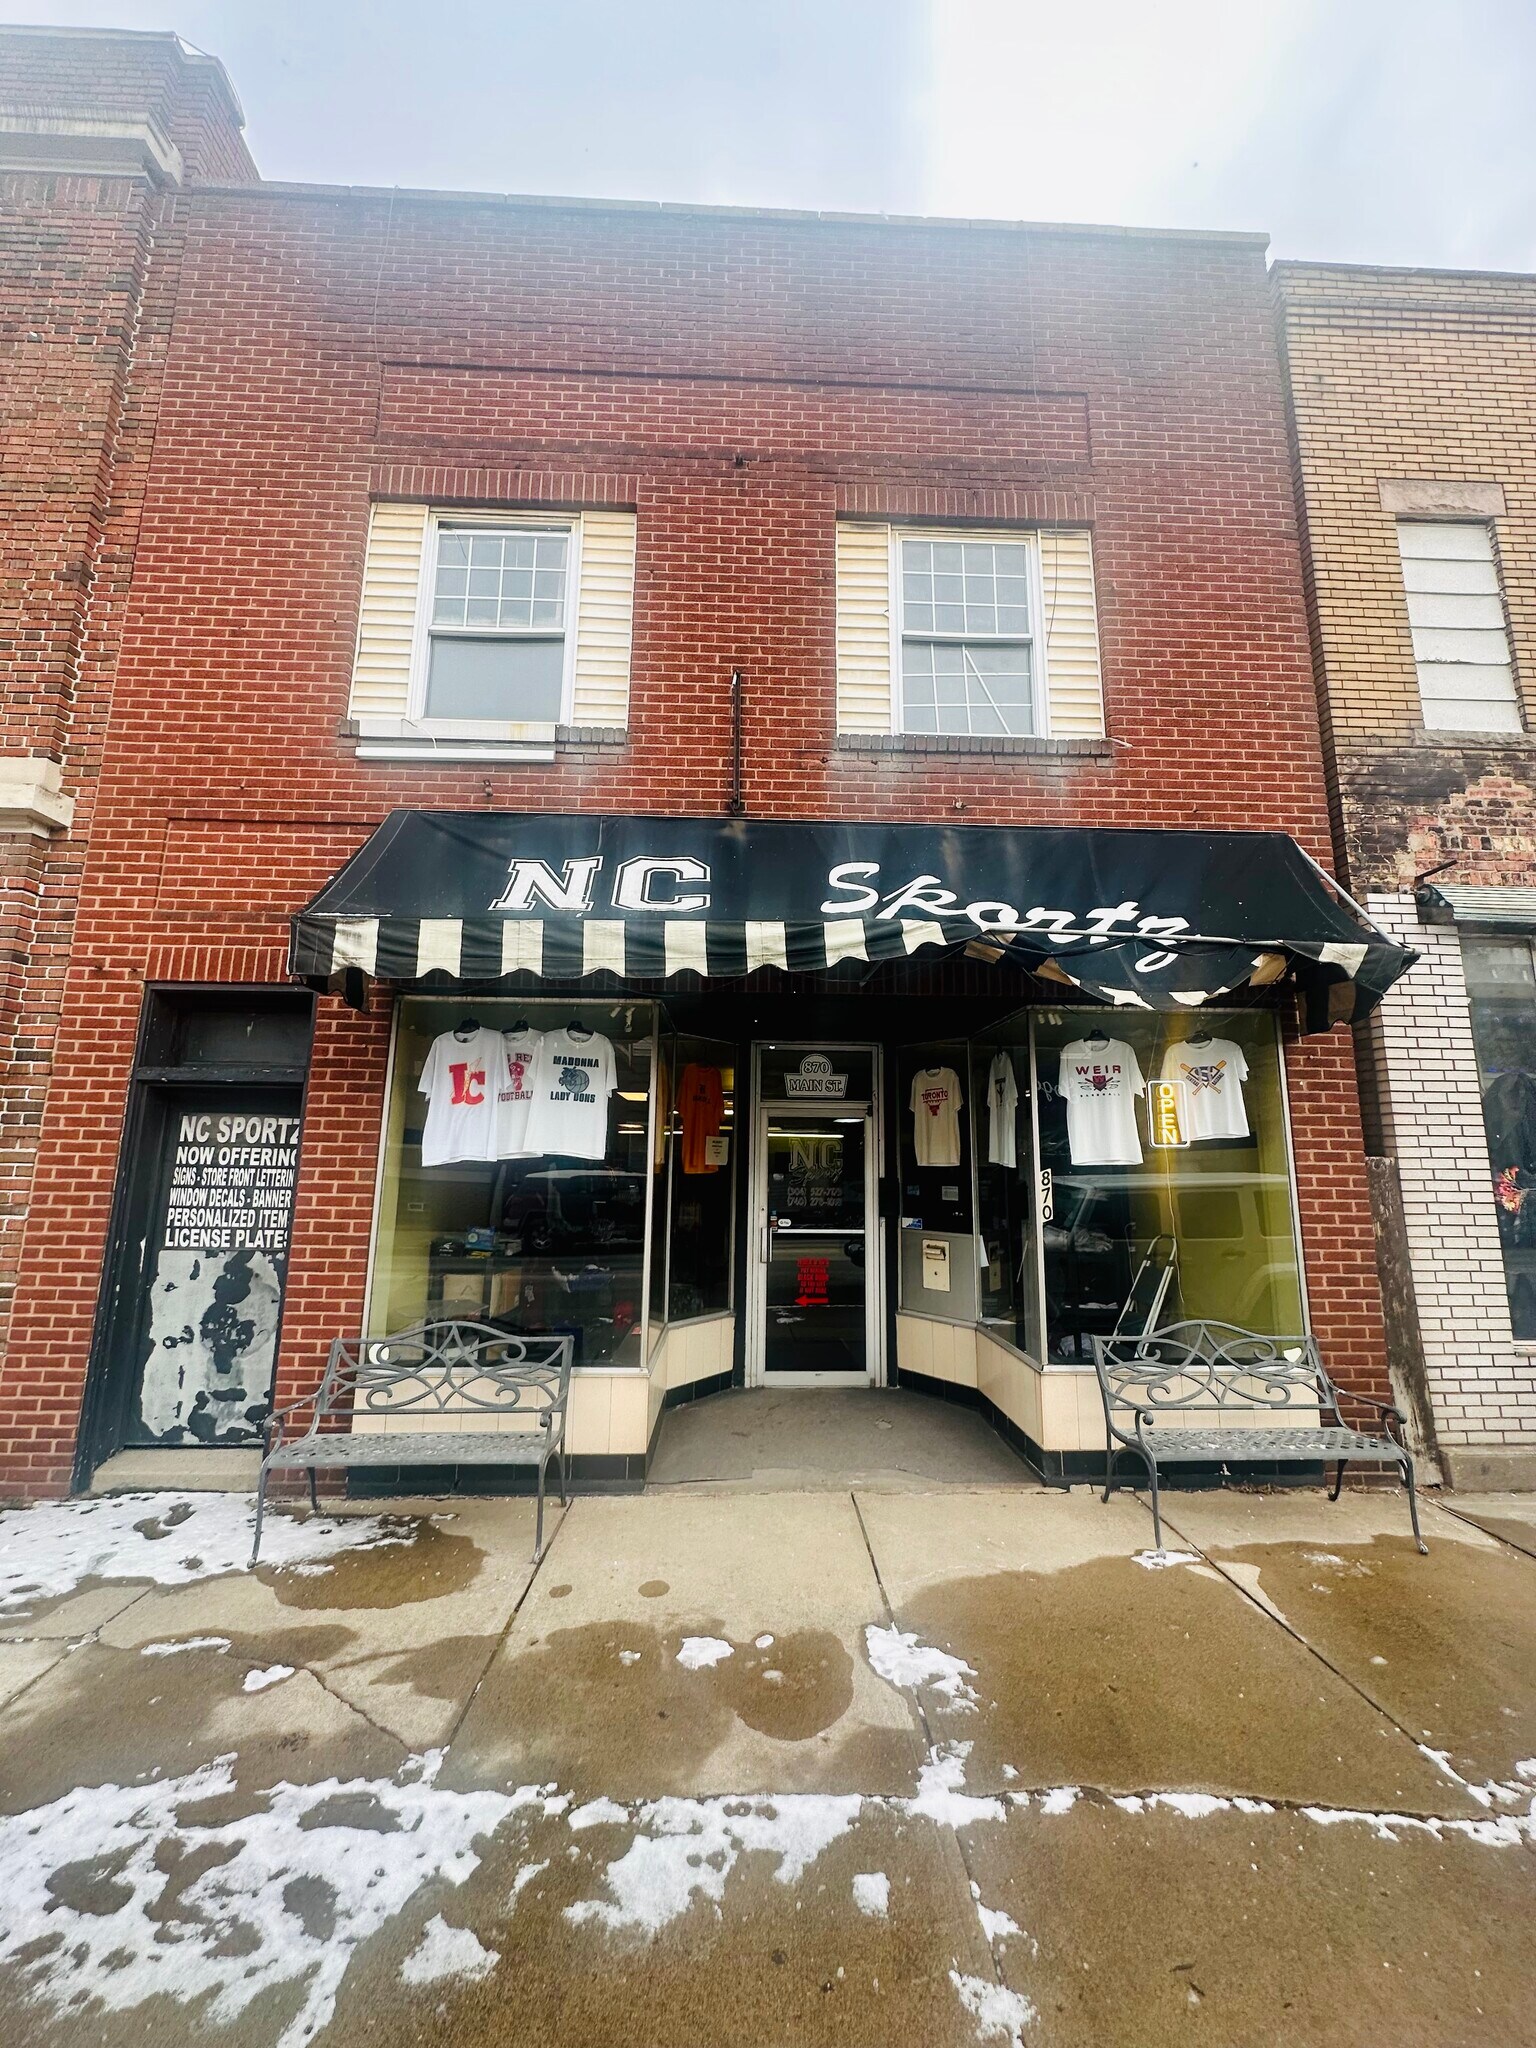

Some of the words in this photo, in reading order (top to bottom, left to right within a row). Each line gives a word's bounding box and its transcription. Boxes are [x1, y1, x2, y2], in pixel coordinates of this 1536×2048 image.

[488, 856, 711, 912] NC
[552, 1055, 600, 1068] MADONNA
[803, 1061, 830, 1074] 870
[1075, 1064, 1121, 1076] WEIR
[789, 1079, 823, 1092] MAIN
[824, 1079, 843, 1092] ST.
[550, 1091, 570, 1101] LADY
[1159, 1083, 1179, 1144] OPEN
[179, 1116, 211, 1143] NC
[176, 1146, 215, 1165] NOW
[788, 1138, 844, 1172] NC
[173, 1167, 197, 1186] SIGNS
[201, 1168, 228, 1186] STORE
[228, 1168, 256, 1186] FRONT
[169, 1187, 209, 1207] WINDOW
[209, 1188, 246, 1208] DECALS
[252, 1189, 292, 1208] BANNER
[1041, 1171, 1052, 1220] 870
[166, 1208, 256, 1227] PERSONALIZED
[258, 1209, 289, 1228] ITEM
[164, 1228, 231, 1247] LICENSE
